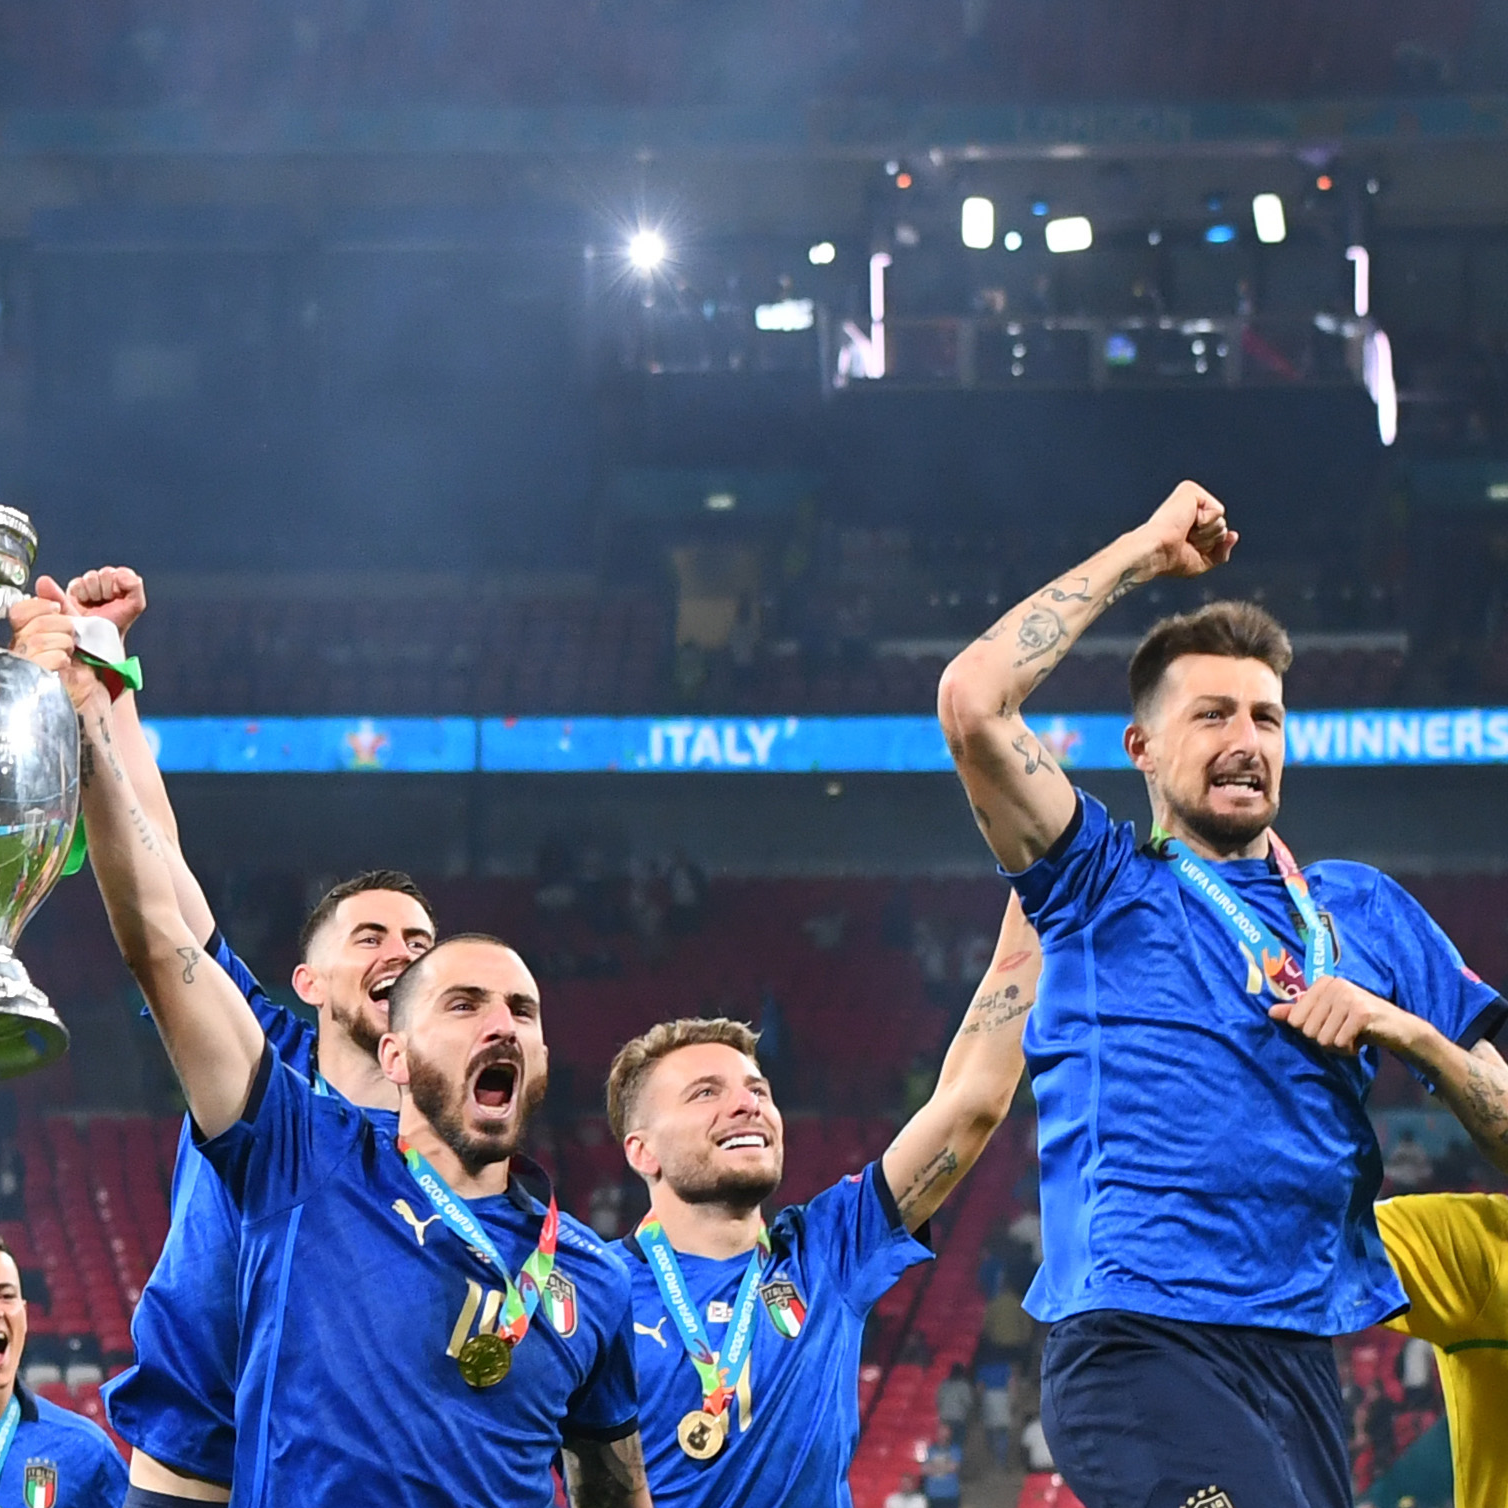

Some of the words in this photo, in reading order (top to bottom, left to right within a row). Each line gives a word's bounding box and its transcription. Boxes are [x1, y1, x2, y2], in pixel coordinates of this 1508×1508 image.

[649, 722, 772, 765] ITALY
[1180, 858, 1209, 890] UEFA
[1206, 883, 1238, 917] EURO
[1232, 912, 1262, 944] 2020
[418, 1173, 452, 1207] 2020
[443, 1202, 480, 1238] EURO
[650, 1243, 673, 1277] 2020
[663, 1270, 685, 1307] EURO
[762, 1284, 794, 1300] ITALIA
[677, 1303, 699, 1333] UEFA
[26, 1465, 55, 1479] ITALIA
